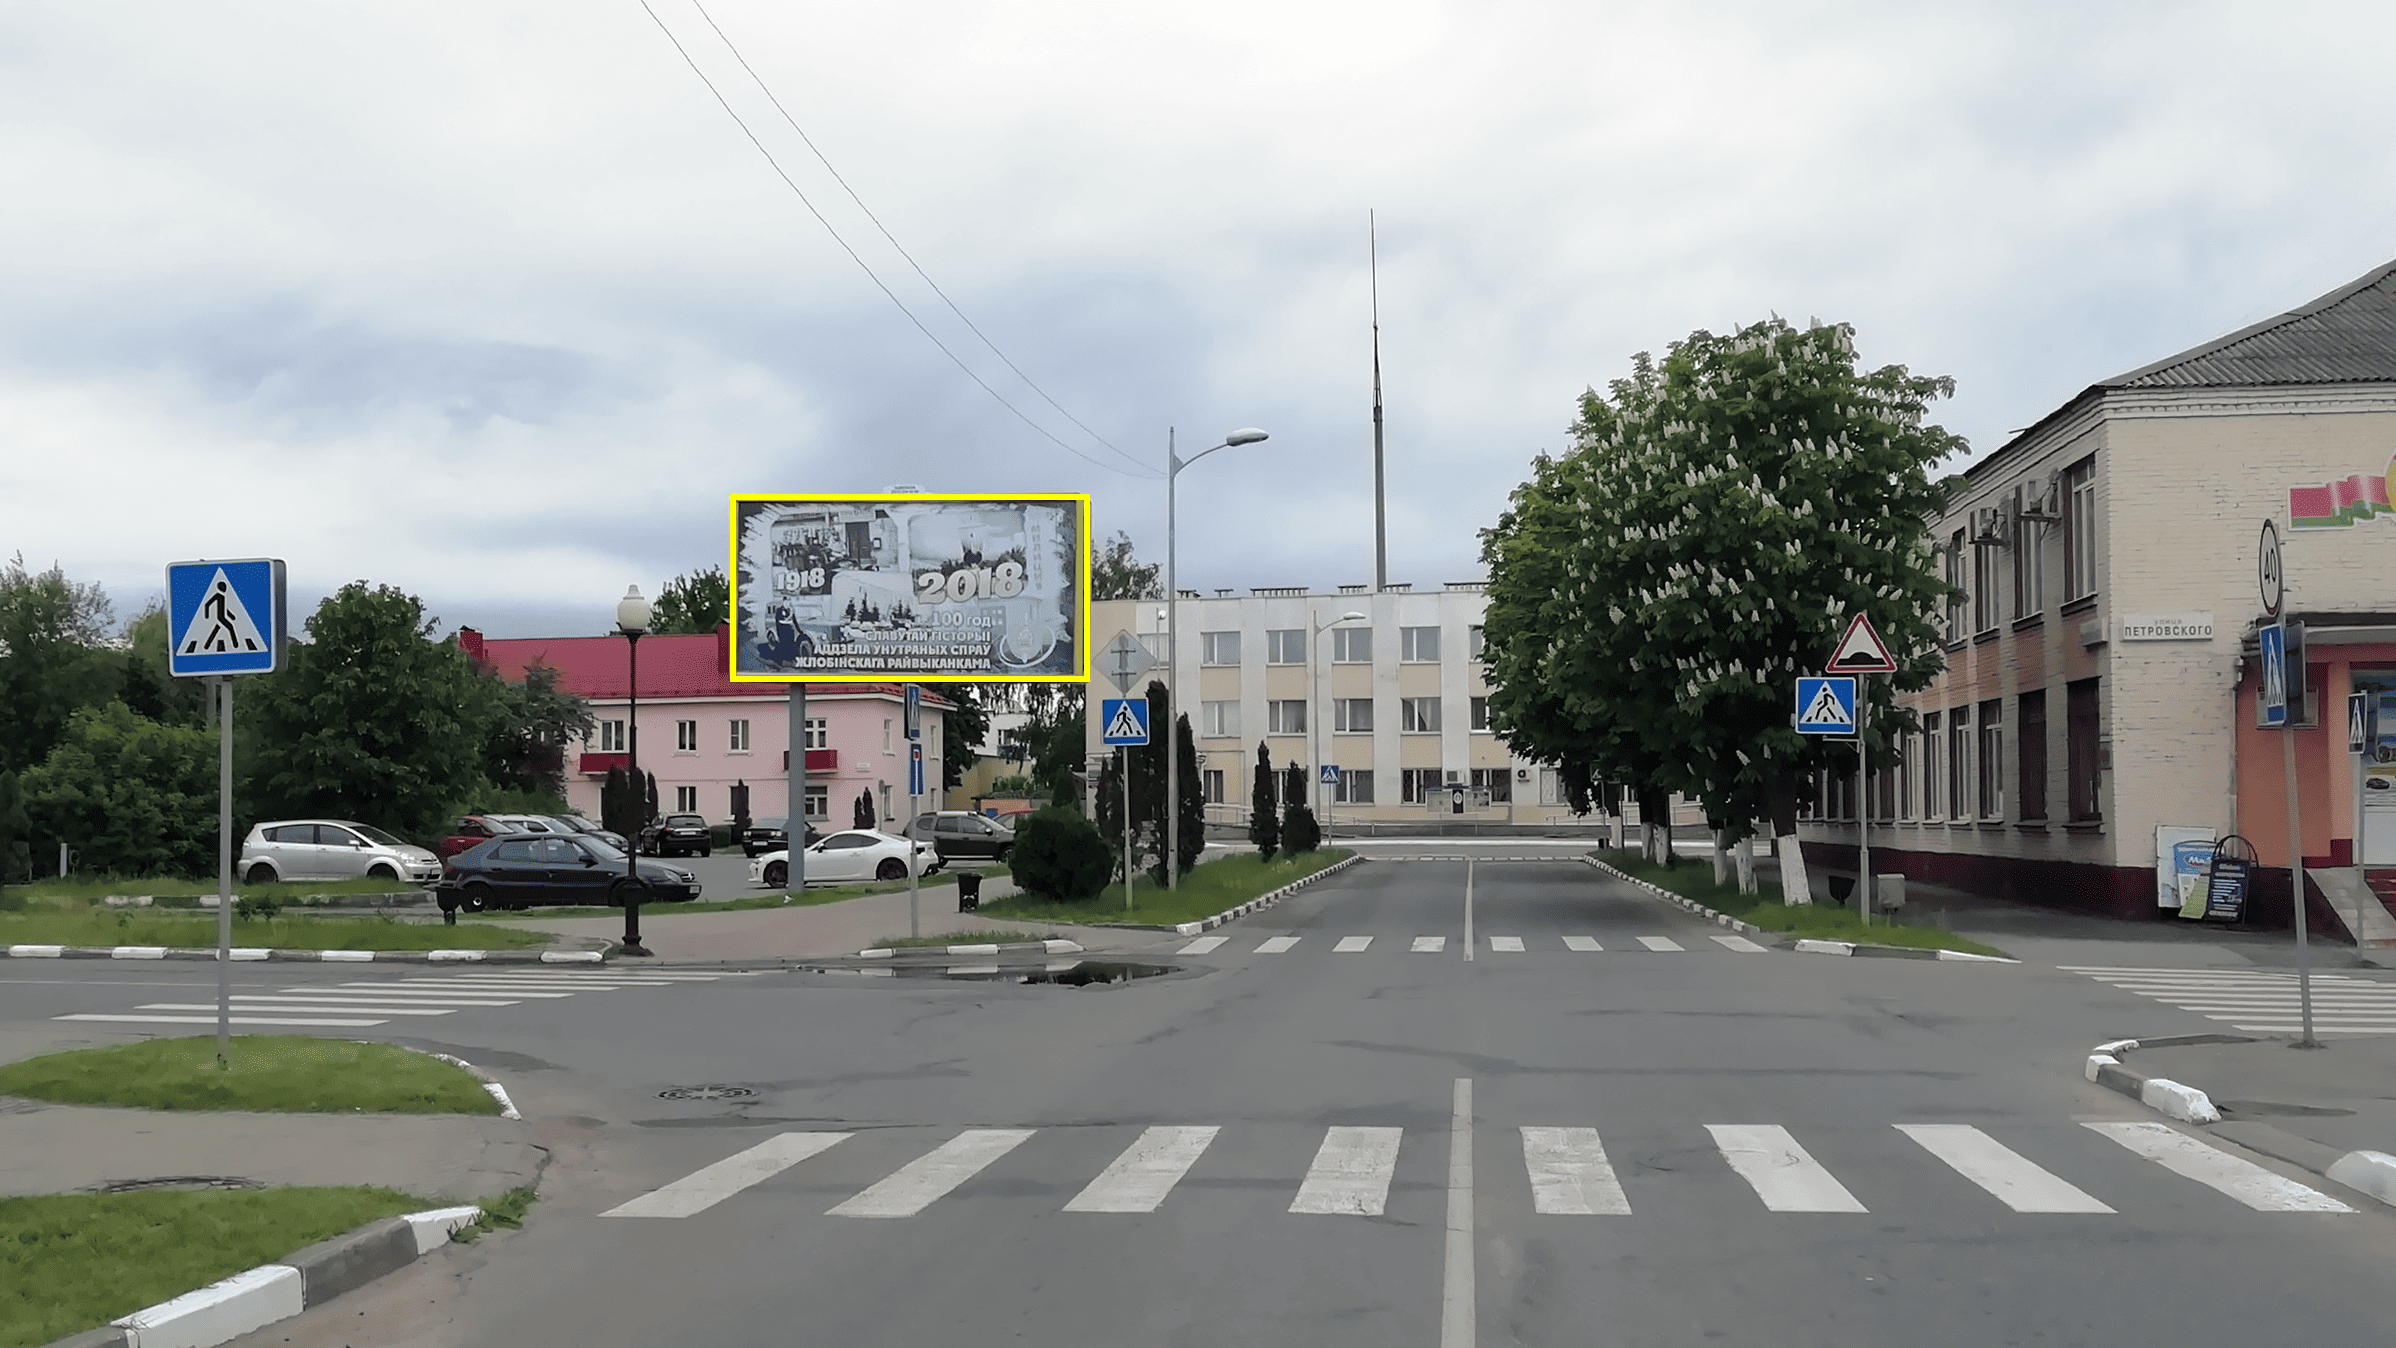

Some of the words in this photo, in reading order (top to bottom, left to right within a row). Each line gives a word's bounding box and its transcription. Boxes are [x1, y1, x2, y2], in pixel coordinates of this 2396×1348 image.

[2264, 548, 2277, 584] 40
[776, 567, 826, 591] 1918
[917, 561, 1024, 604] 2018
[932, 611, 964, 627] 100
[966, 615, 992, 628] год
[931, 631, 992, 642] ГІСТОРЫІ
[2124, 626, 2213, 636] ПЕТРОВСКОГО
[813, 643, 871, 656] АДДЗЕЛА
[874, 641, 949, 655] ЎНУТРАНЫХ
[950, 641, 992, 655] СПРАЎ
[794, 656, 886, 669] ЖЛОБІНСКАГА
[887, 656, 992, 669] РАЙВЫКАНКАМА
